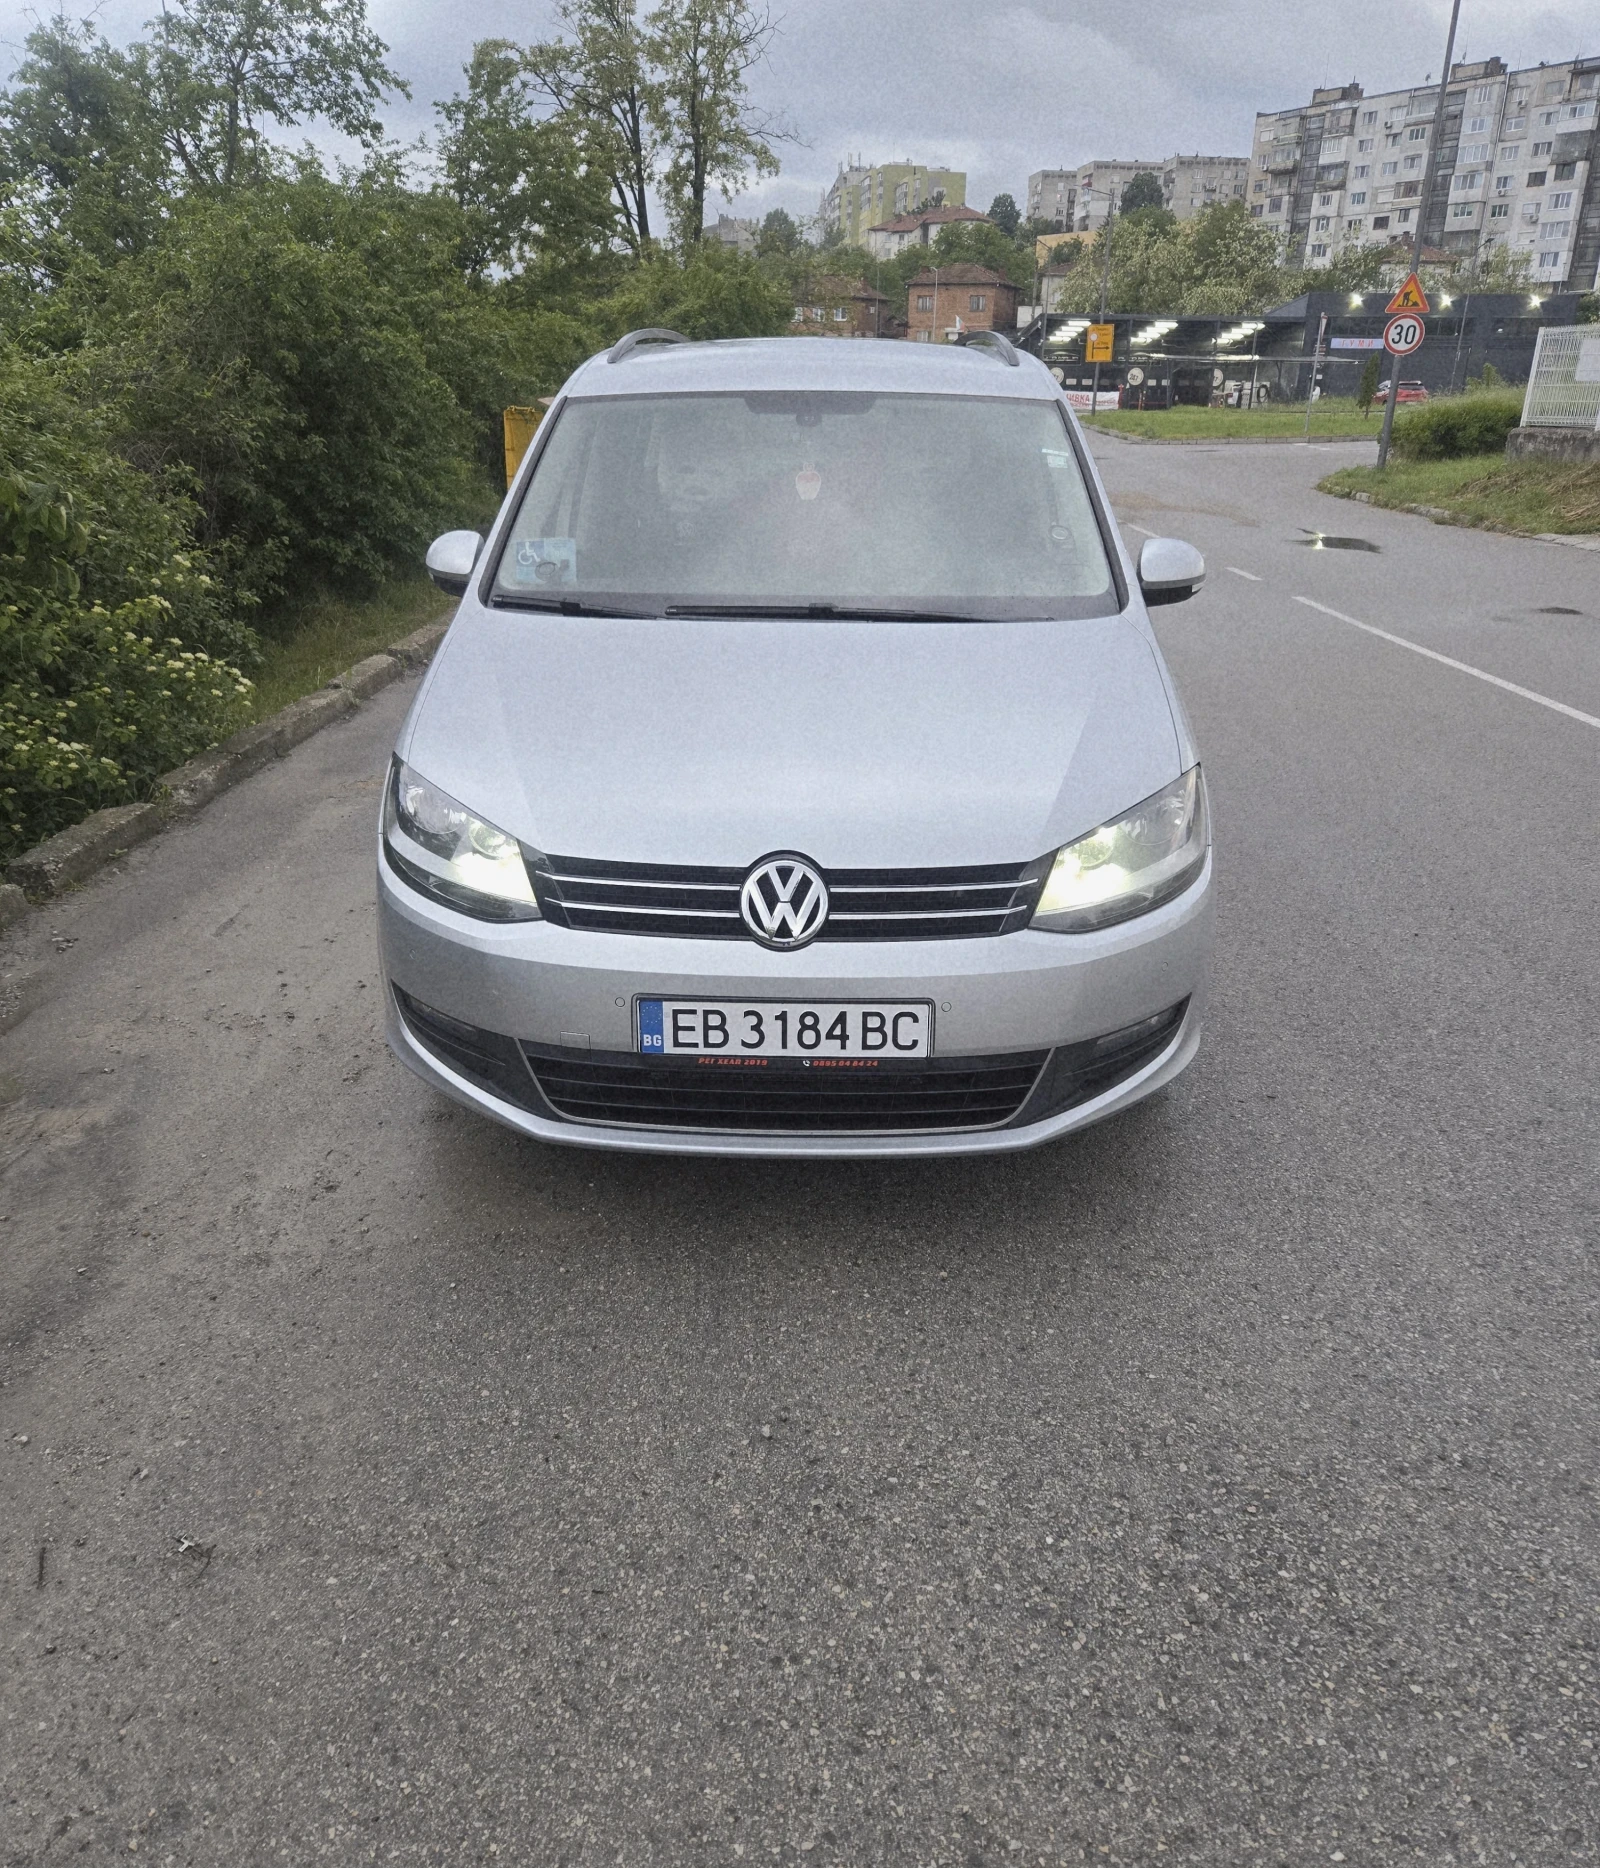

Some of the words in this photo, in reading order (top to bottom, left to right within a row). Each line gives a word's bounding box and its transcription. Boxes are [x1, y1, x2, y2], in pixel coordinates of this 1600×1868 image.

[1391, 324, 1417, 345] 30
[741, 860, 828, 942] VW
[643, 1034, 662, 1047] BG
[671, 1008, 730, 1049] EB
[740, 1009, 850, 1050] 3184
[861, 1010, 920, 1051] BC
